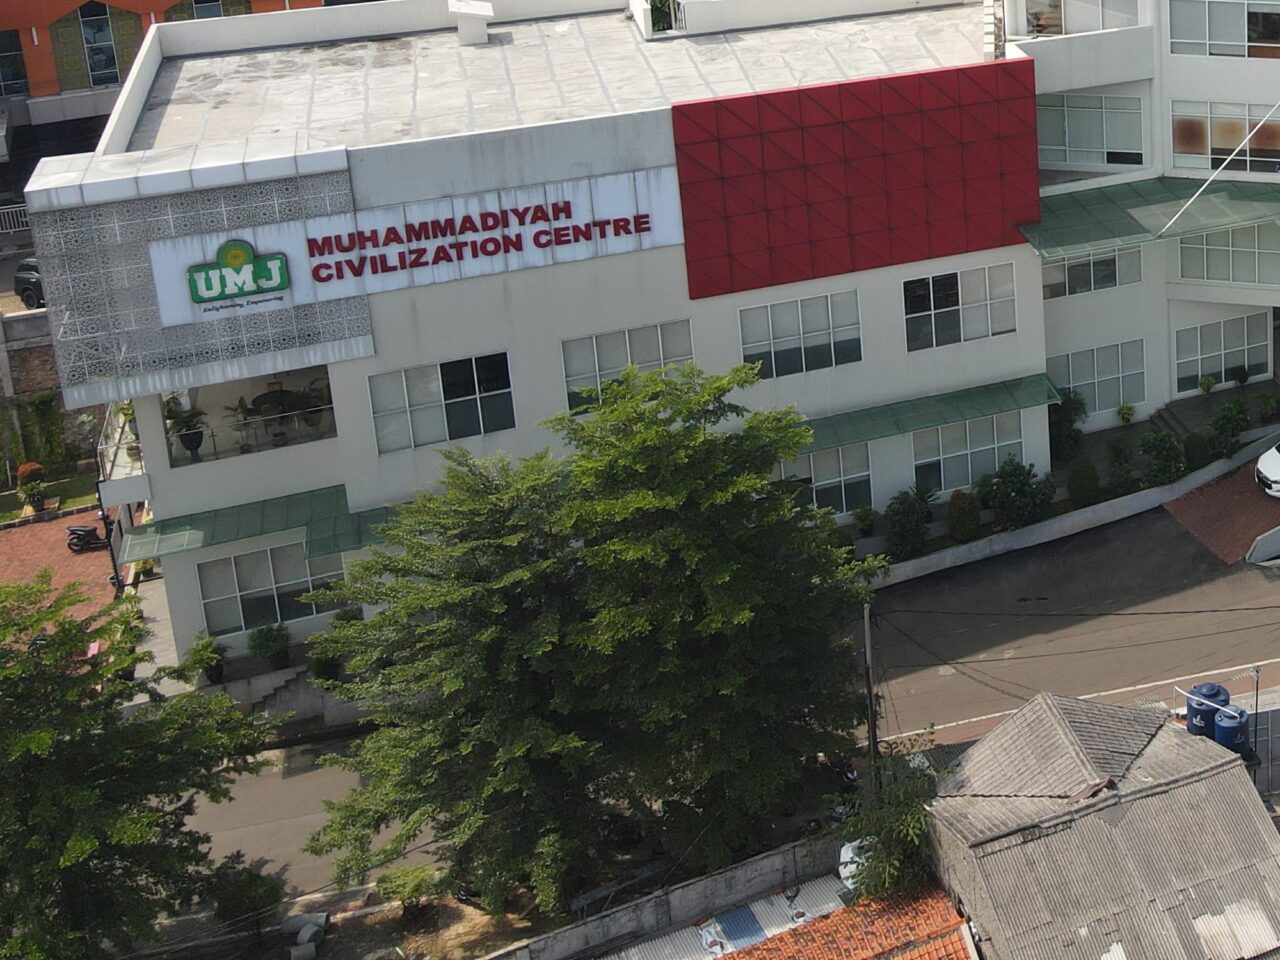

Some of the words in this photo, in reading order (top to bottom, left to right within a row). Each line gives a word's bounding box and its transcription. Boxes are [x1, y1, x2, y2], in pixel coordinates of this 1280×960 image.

[307, 201, 572, 257] MUHAMMADIYAH
[312, 233, 523, 283] CIVILIZATION
[532, 214, 651, 248] CENTRE
[193, 259, 281, 298] UMJ
